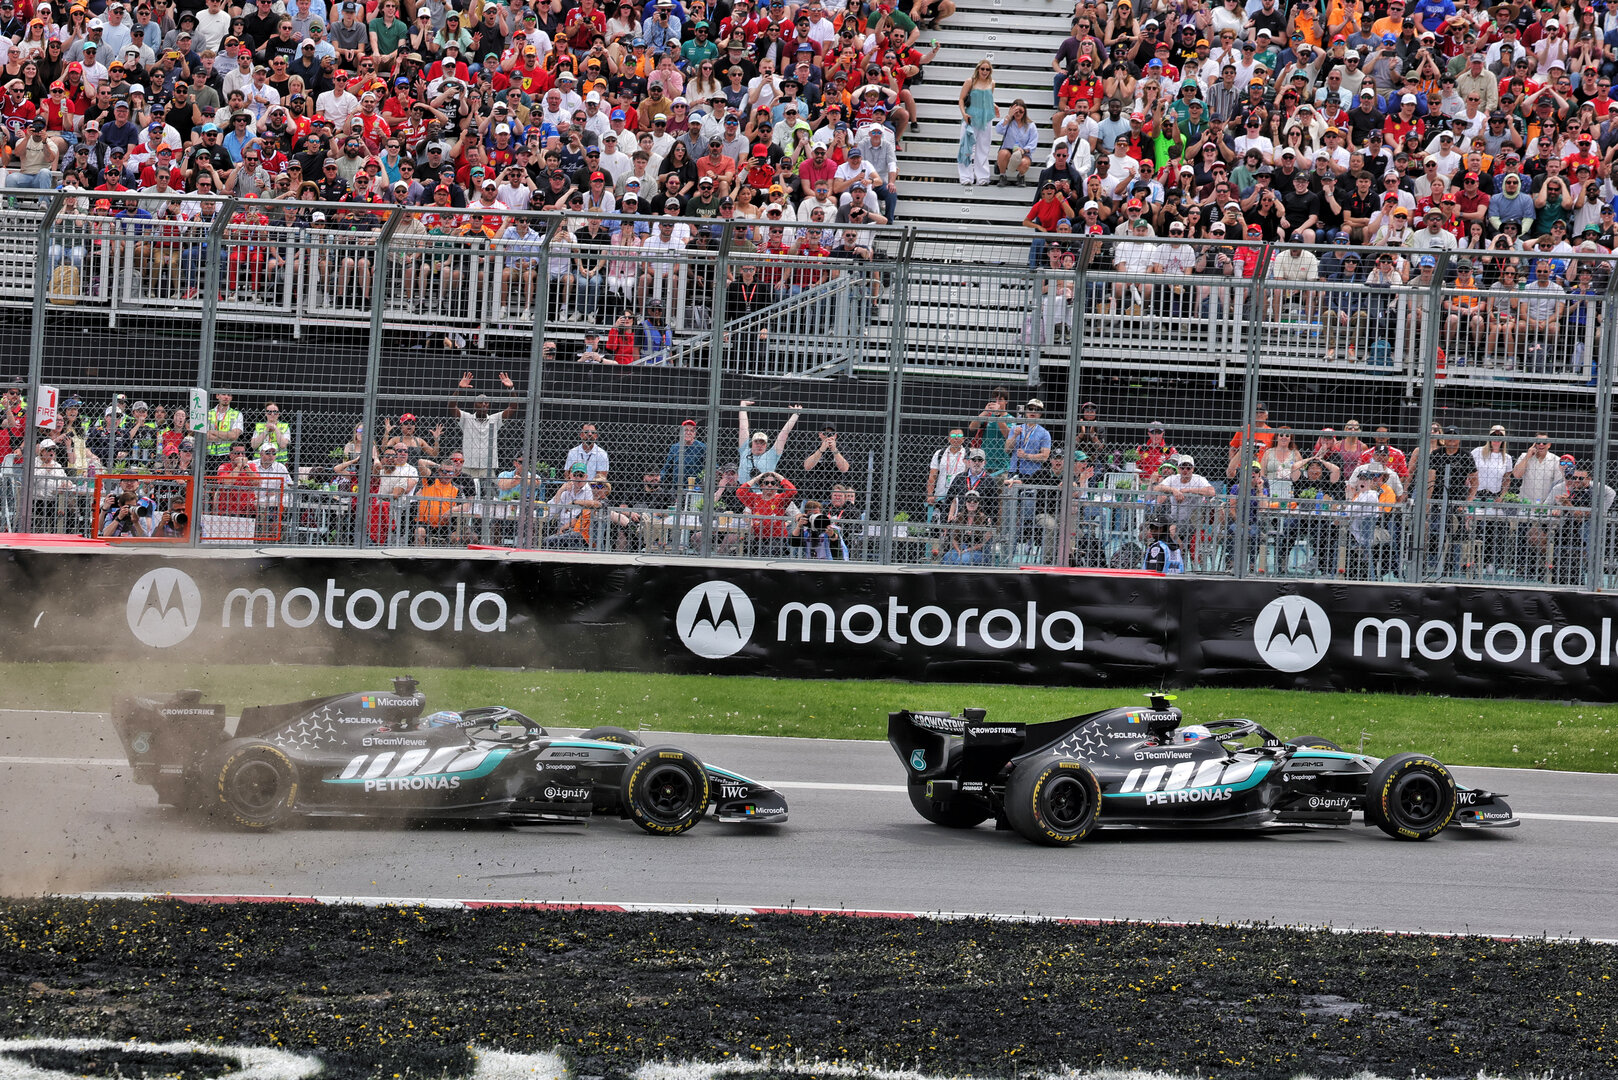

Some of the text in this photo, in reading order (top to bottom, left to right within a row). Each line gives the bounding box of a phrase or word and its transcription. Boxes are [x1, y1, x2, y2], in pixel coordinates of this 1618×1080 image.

[37, 406, 56, 418] FIRE
[190, 412, 206, 420] EXIT
[222, 578, 508, 632] motorola
[777, 596, 1084, 651] motorola
[1354, 612, 1618, 666] motorol
[378, 698, 419, 706] Microsoft
[162, 708, 215, 716] CROWDSTRIKE
[1140, 712, 1177, 722] Microsoft
[456, 720, 470, 729] AMD
[373, 738, 427, 746] TeamViewer
[1214, 734, 1228, 742] AMD
[659, 752, 684, 760] PIRELLI
[1144, 751, 1192, 759] TeamViewer
[1404, 760, 1448, 776] P ZERO
[364, 776, 461, 792] PETRONAS
[722, 786, 748, 798] IWC
[1145, 788, 1233, 806] PETRONAS
[646, 822, 682, 832] ZERO
[1046, 830, 1078, 842] ZERO
[1398, 827, 1420, 838] PIRELLI
